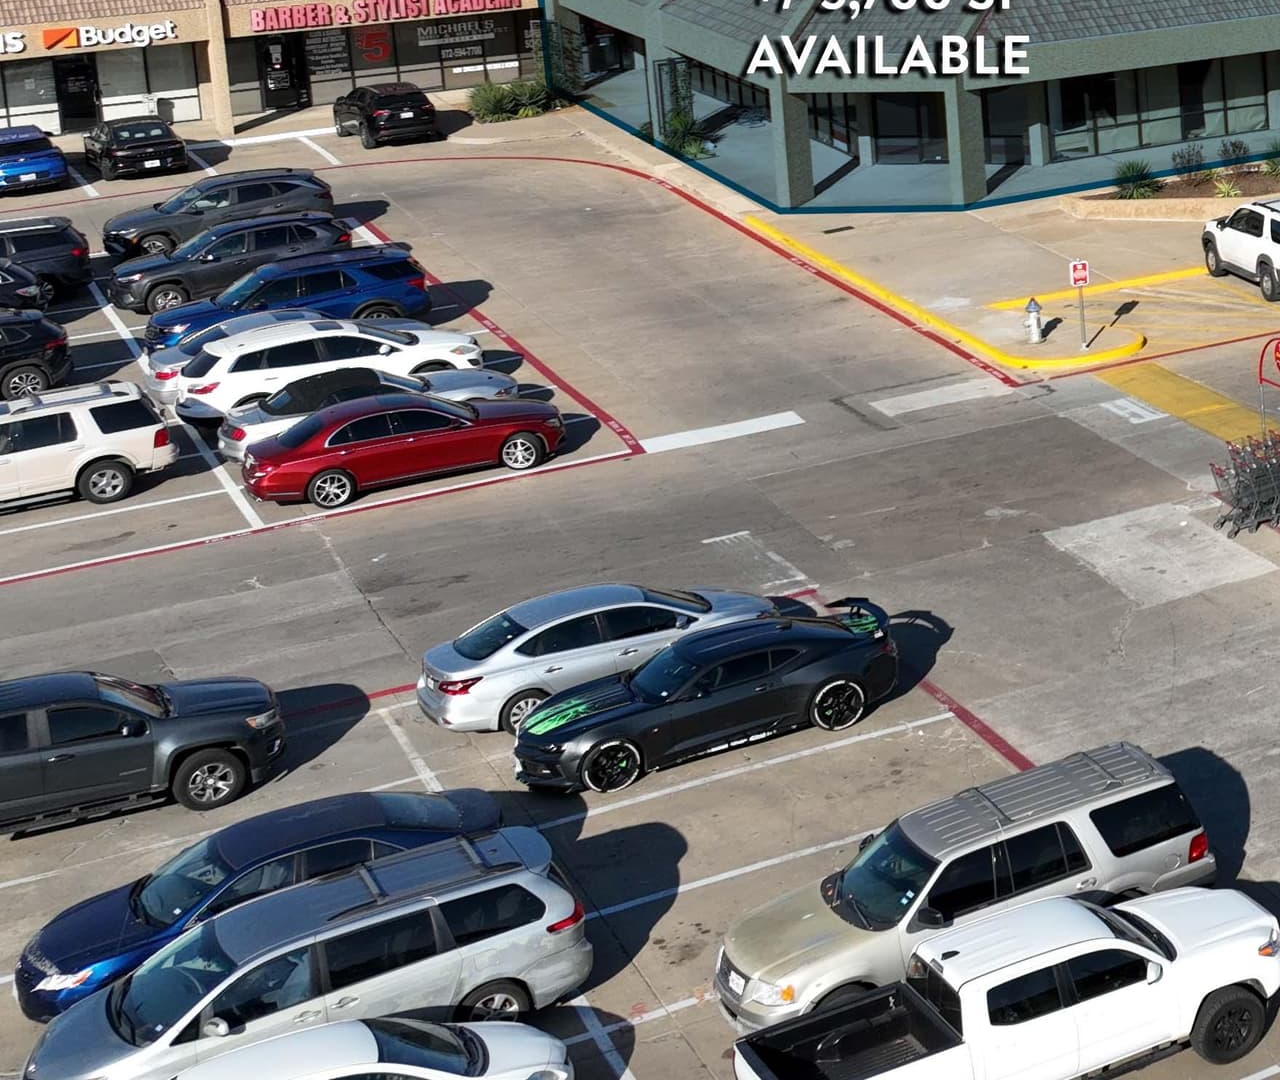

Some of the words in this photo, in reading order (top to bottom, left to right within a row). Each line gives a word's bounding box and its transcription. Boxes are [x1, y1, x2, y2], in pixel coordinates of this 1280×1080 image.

[251, 3, 333, 32] BARBER
[335, 4, 351, 24] &
[79, 20, 177, 48] Budget
